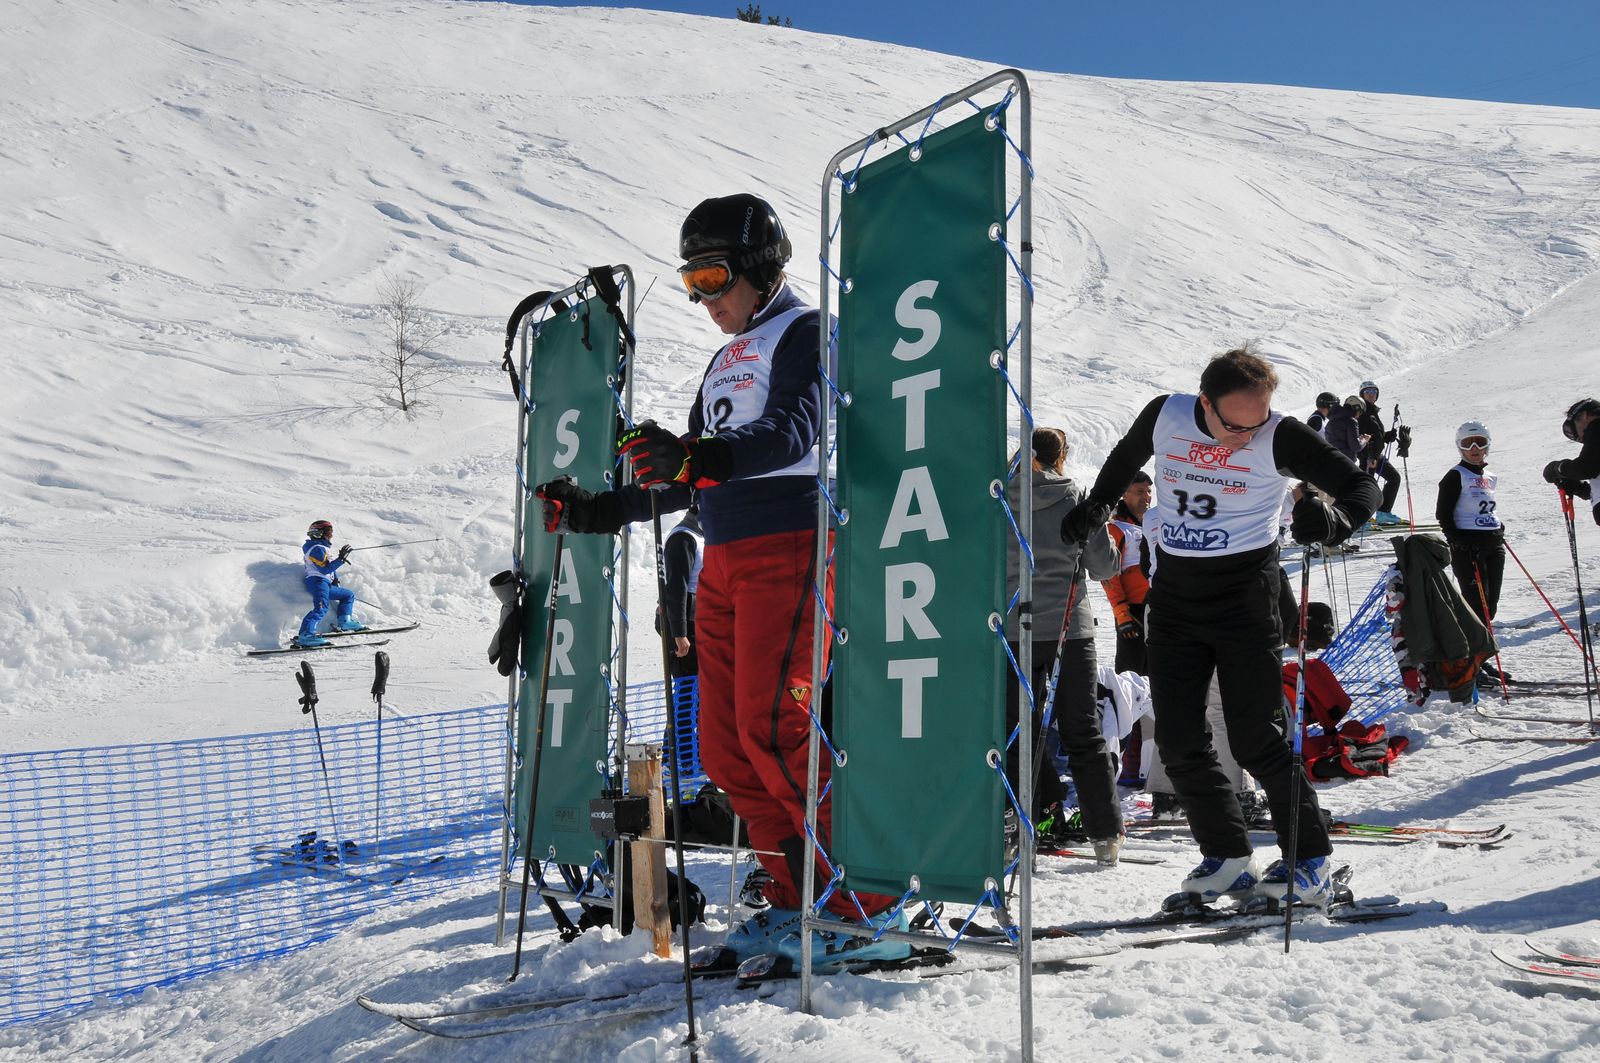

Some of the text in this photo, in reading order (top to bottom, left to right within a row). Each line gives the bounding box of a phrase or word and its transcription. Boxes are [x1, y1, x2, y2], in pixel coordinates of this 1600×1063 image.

[742, 206, 754, 247] BRIKO
[741, 243, 782, 269] uvex
[712, 372, 754, 390] BONALDI
[617, 430, 642, 448] LEKI
[1190, 443, 1234, 455] PERICO
[1188, 450, 1231, 467] SPORT
[1185, 473, 1247, 489] BONALDI
[879, 279, 950, 739] START
[1172, 489, 1217, 520] 13
[1479, 500, 1496, 515] 27
[543, 408, 582, 747] SART
